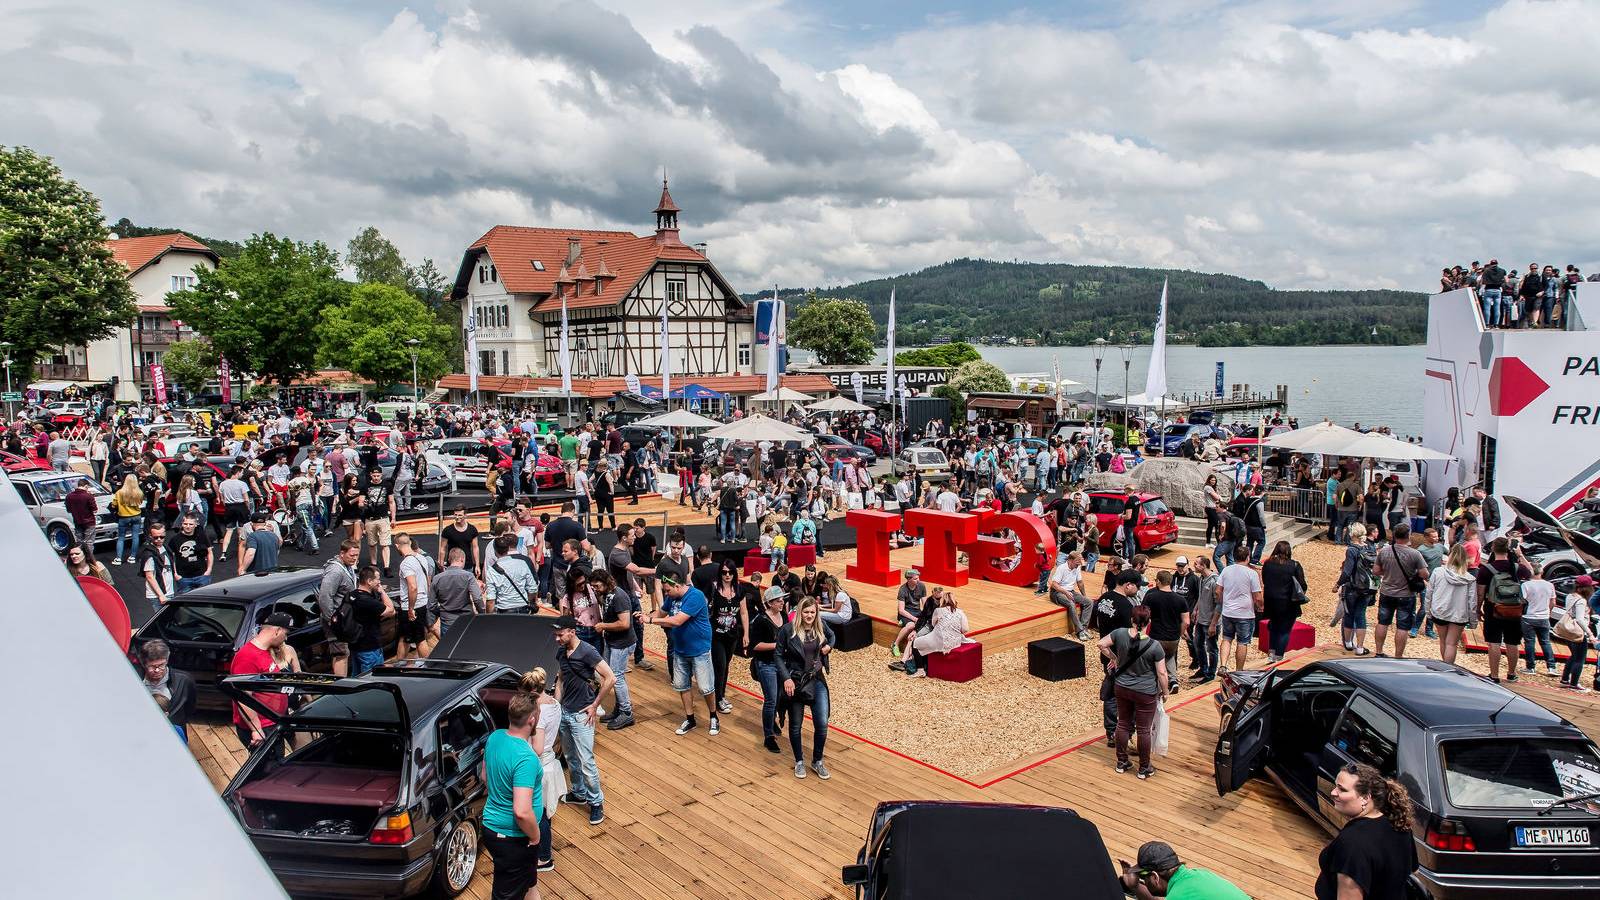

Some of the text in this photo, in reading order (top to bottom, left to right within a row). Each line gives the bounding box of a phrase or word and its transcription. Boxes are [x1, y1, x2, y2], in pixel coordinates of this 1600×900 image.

[830, 372, 953, 386] SERESURAN
[1525, 829, 1541, 843] ME
[1566, 829, 1589, 843] 160
